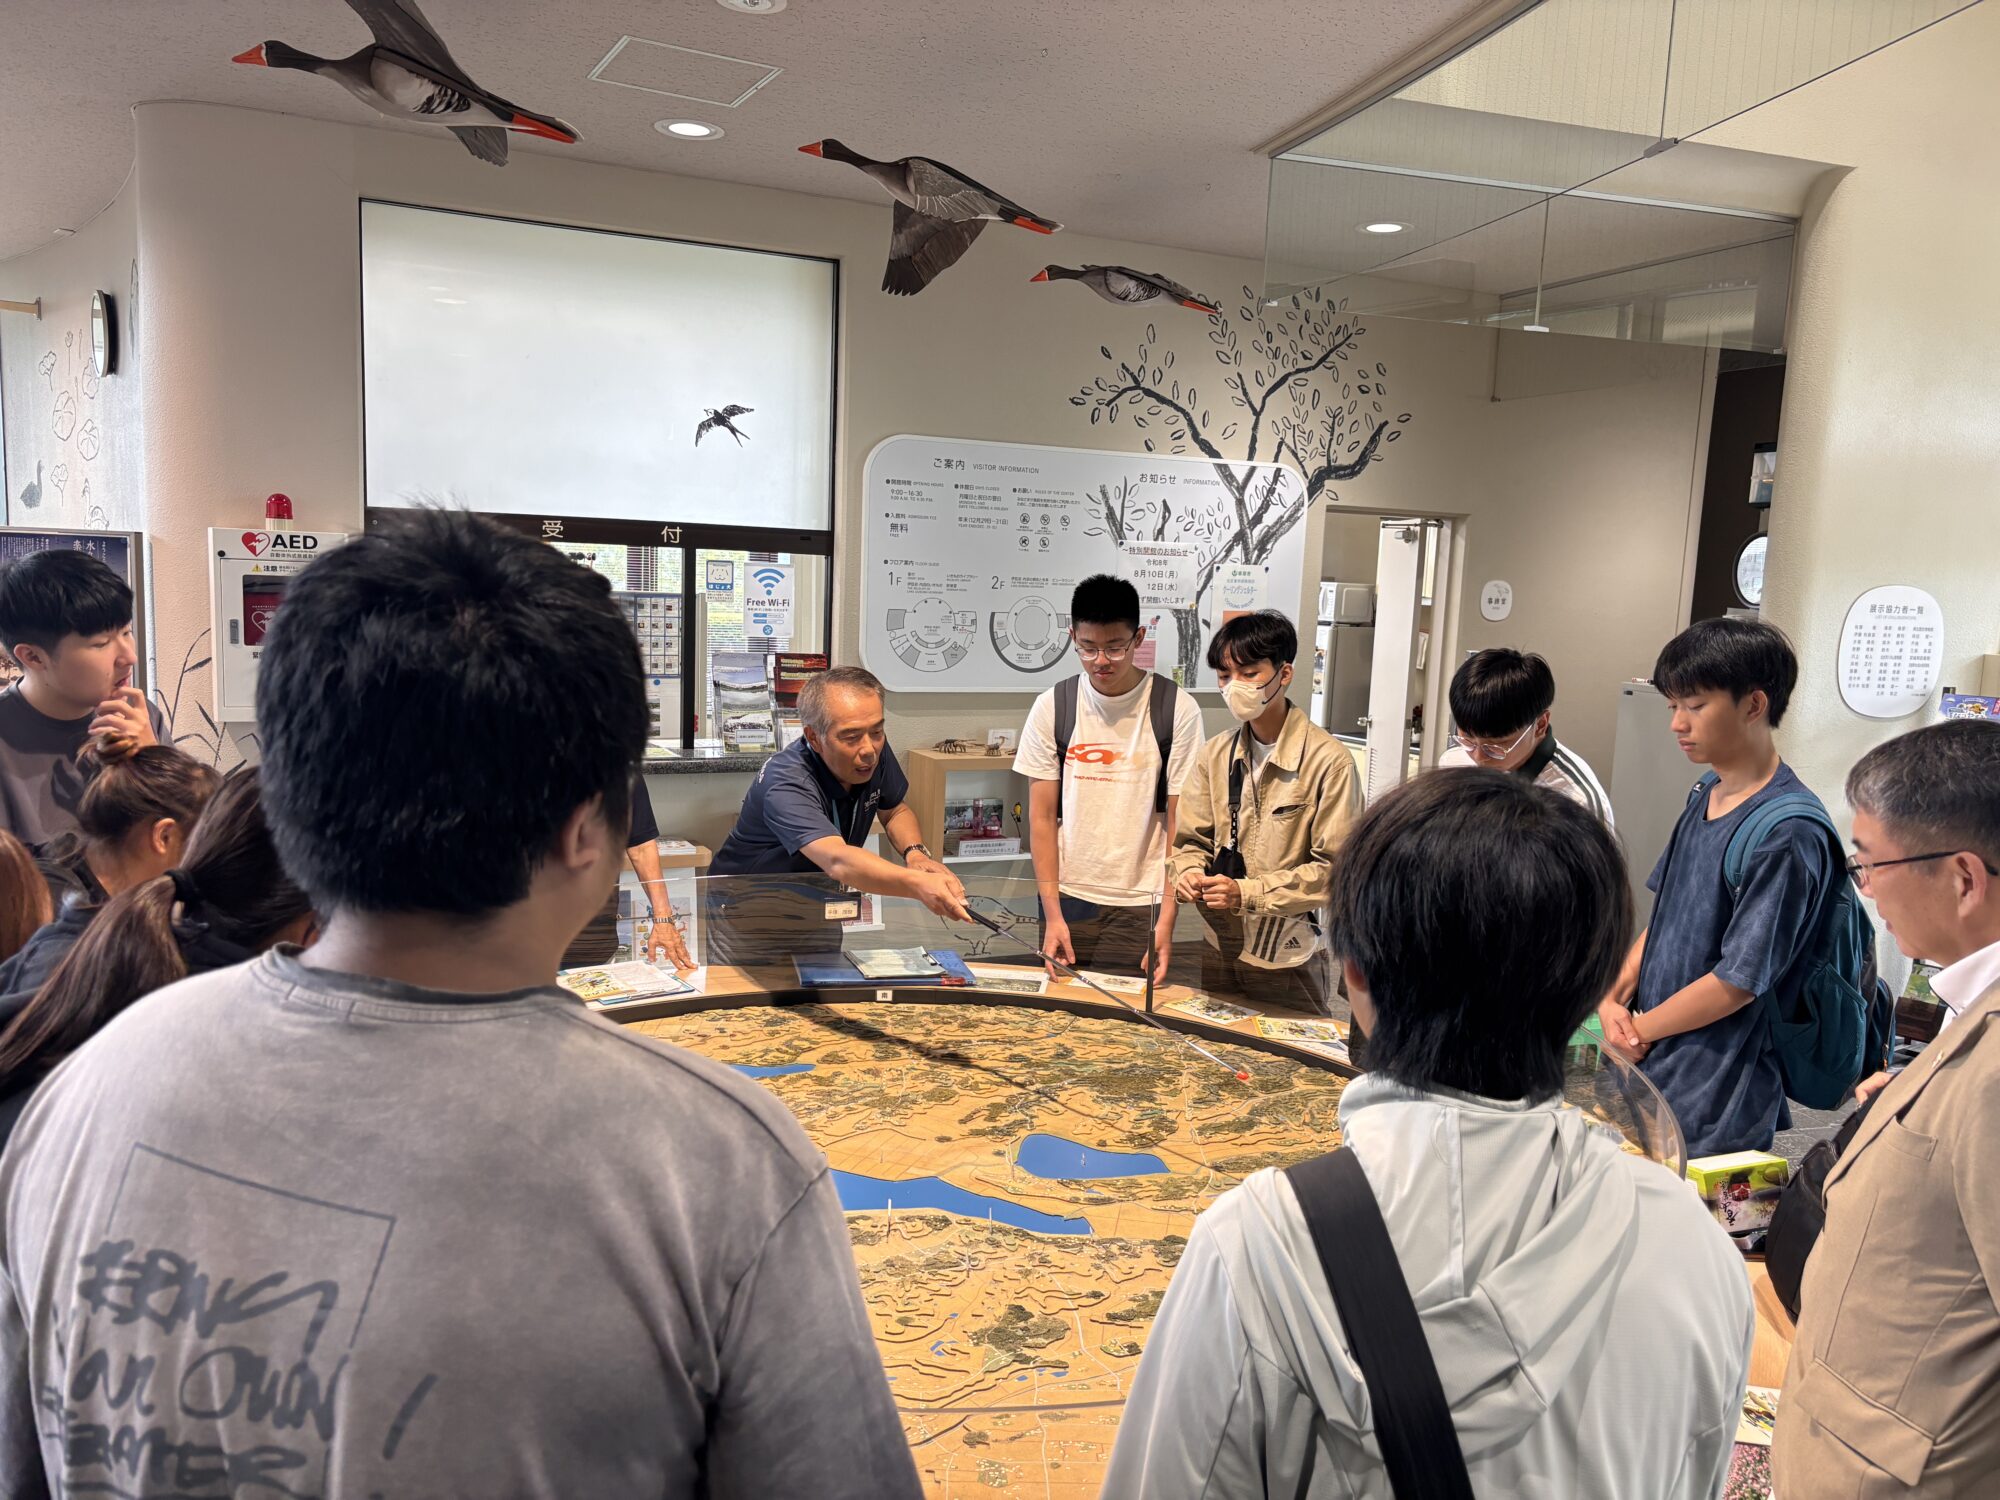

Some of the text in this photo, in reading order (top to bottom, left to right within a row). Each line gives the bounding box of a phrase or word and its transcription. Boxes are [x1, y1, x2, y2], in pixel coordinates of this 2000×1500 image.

[933, 457, 966, 471] ご案内
[972, 463, 1040, 474] VISITOR INFORMATION
[1139, 473, 1177, 484] お知らせ
[1183, 478, 1220, 487] INFORMATION
[541, 520, 564, 539] 受
[890, 522, 909, 533] 無料
[661, 525, 683, 544] 付
[271, 534, 318, 550] AED
[888, 571, 902, 586] 1F
[1133, 569, 1179, 579] 8月10日(月)
[991, 575, 1005, 590] 2F
[1147, 582, 1178, 591] 12日(水)
[746, 598, 790, 607] Free Wi-Fi
[1869, 604, 1924, 615] 展示協力者一覧
